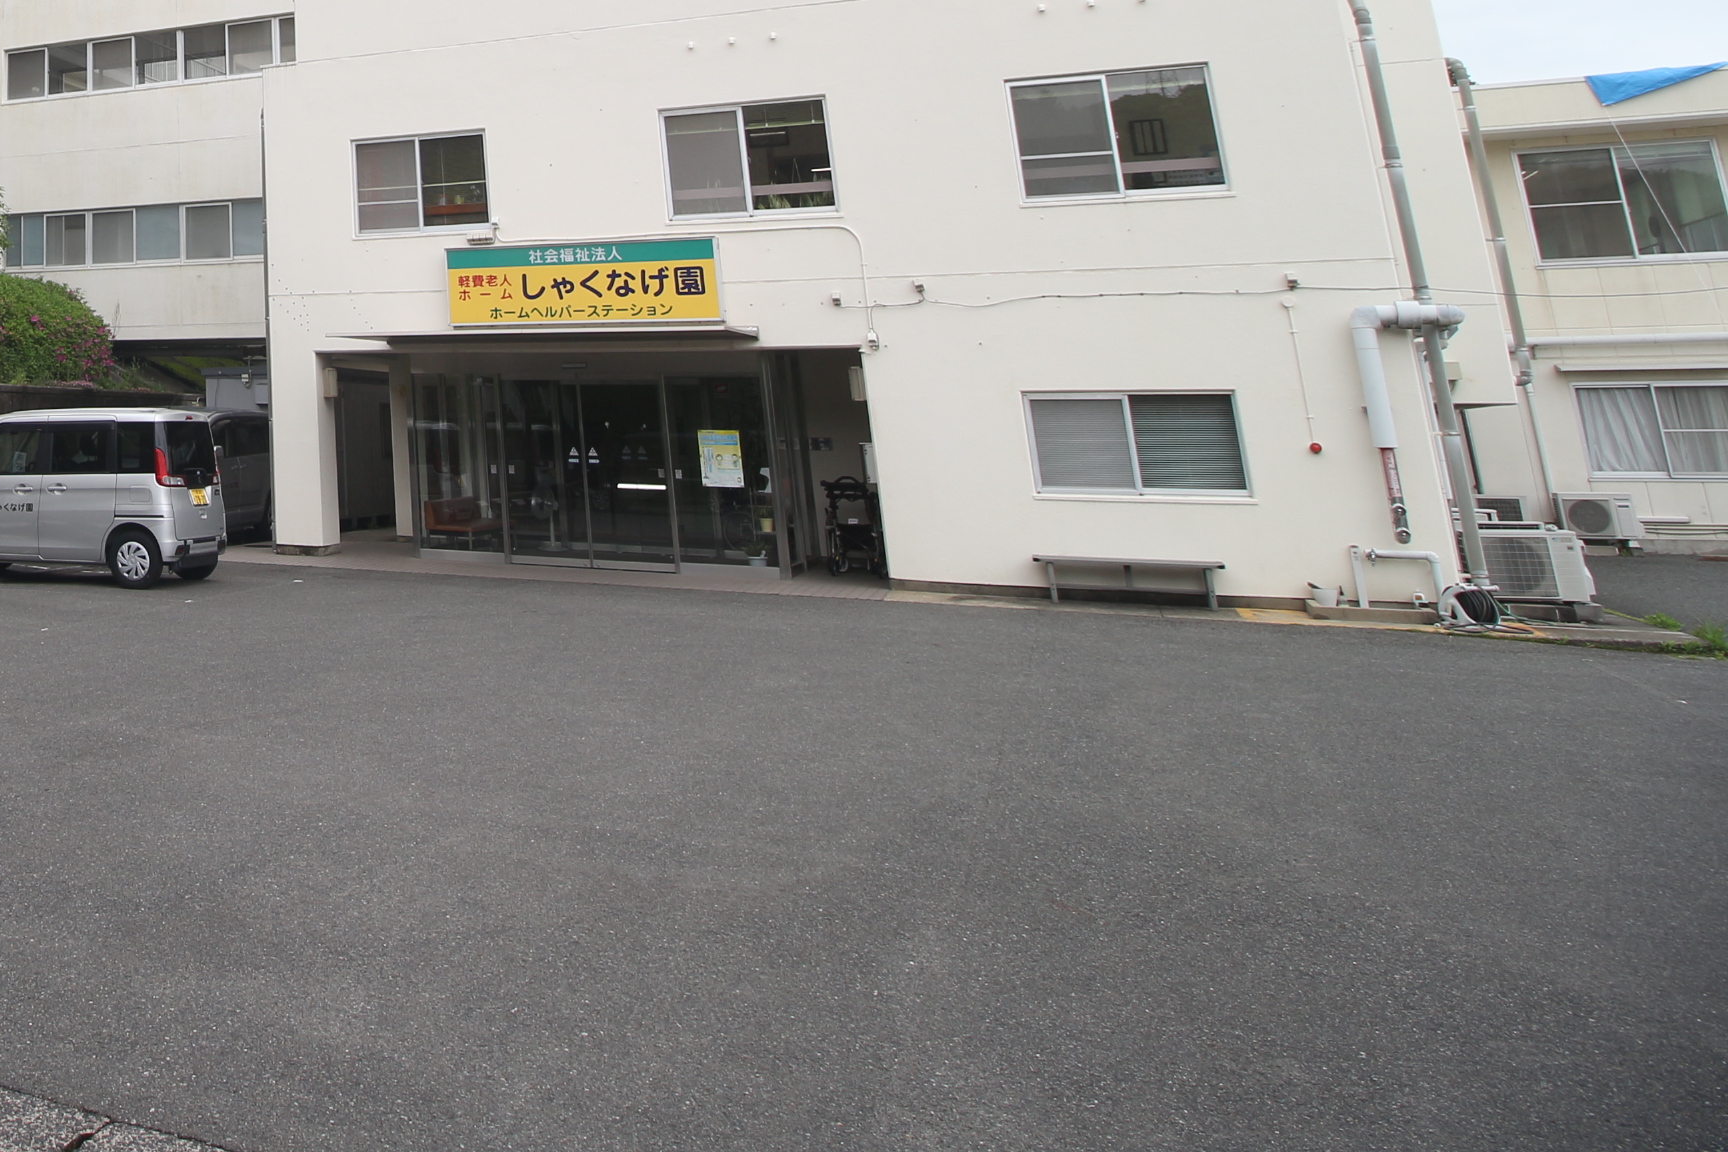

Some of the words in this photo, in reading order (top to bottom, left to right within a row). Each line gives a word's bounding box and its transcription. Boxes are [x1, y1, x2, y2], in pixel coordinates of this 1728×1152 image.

[528, 246, 622, 264] 社会福祉法人
[458, 273, 513, 288] 軽費老人
[521, 266, 705, 300] しゃくなげ園
[458, 288, 514, 301] ホーム
[489, 303, 674, 320] ホームヘルパーステーション
